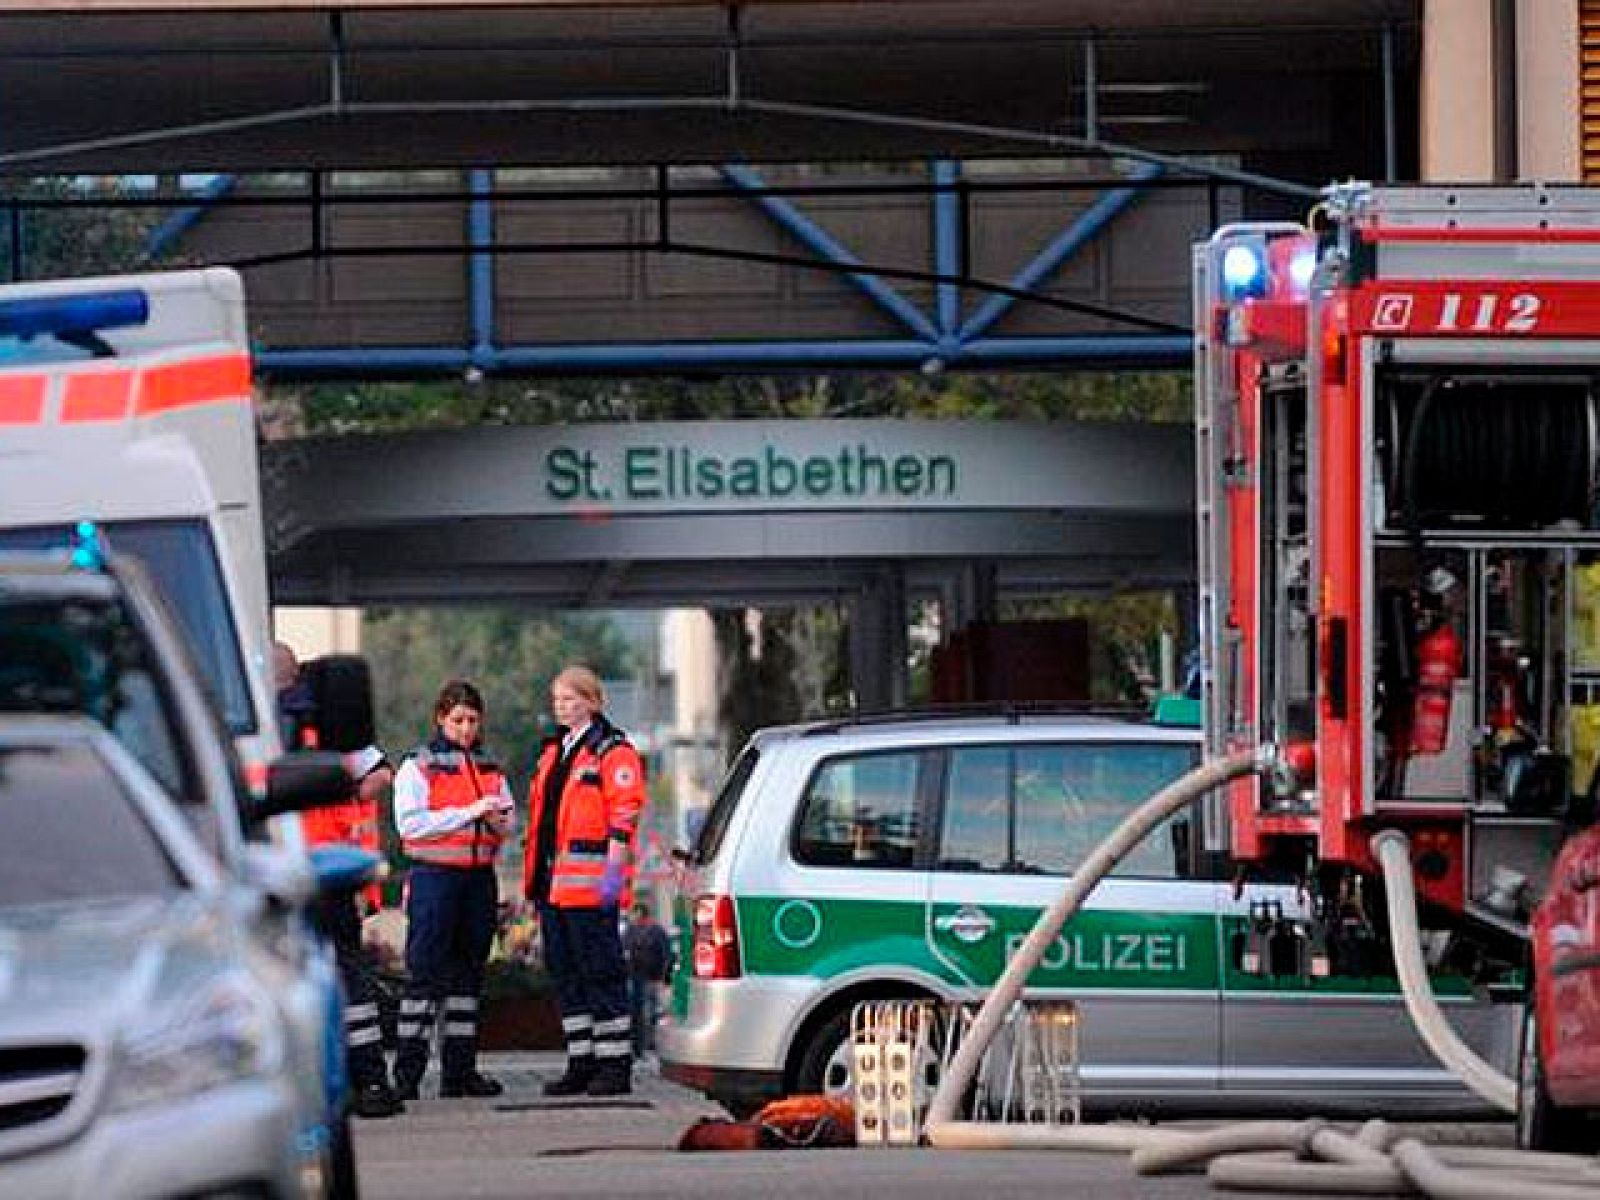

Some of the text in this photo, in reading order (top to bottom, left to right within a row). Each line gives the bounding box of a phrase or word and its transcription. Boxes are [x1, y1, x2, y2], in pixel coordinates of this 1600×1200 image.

[1436, 294, 1541, 331] 112
[545, 444, 957, 500] St. Elisabethen
